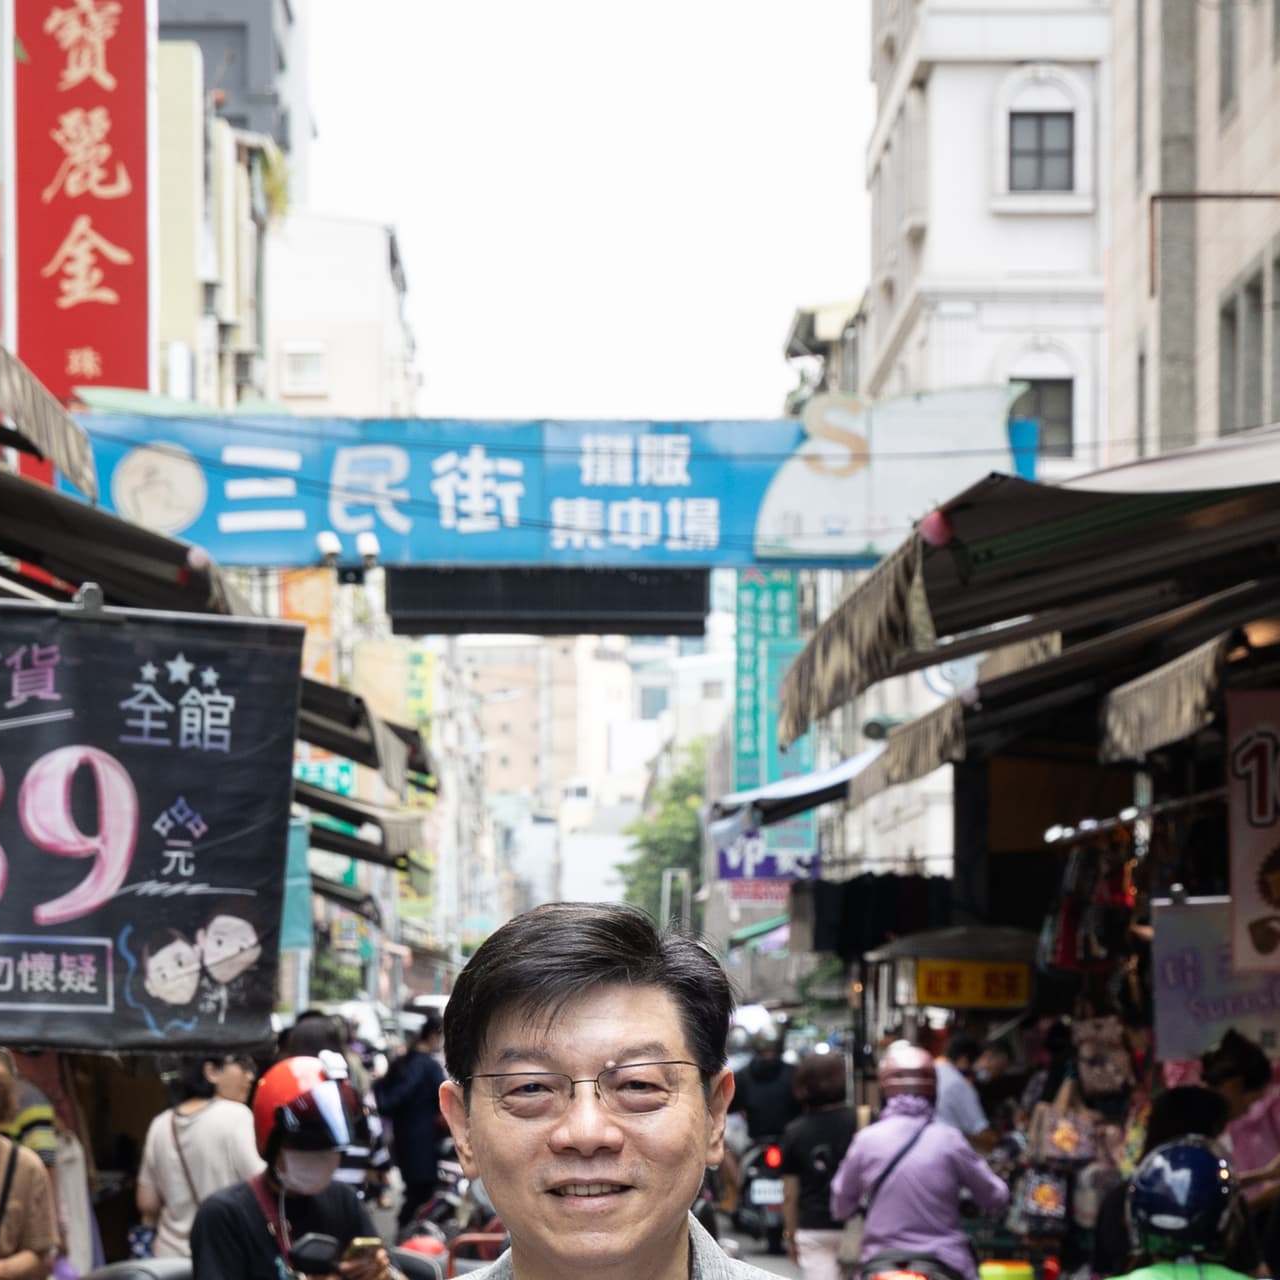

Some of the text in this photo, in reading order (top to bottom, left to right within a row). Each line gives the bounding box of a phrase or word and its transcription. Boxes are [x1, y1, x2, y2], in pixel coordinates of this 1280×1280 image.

[217, 443, 525, 535] 三民街
[550, 497, 719, 551] 集中場
[119, 681, 235, 753] 全館
